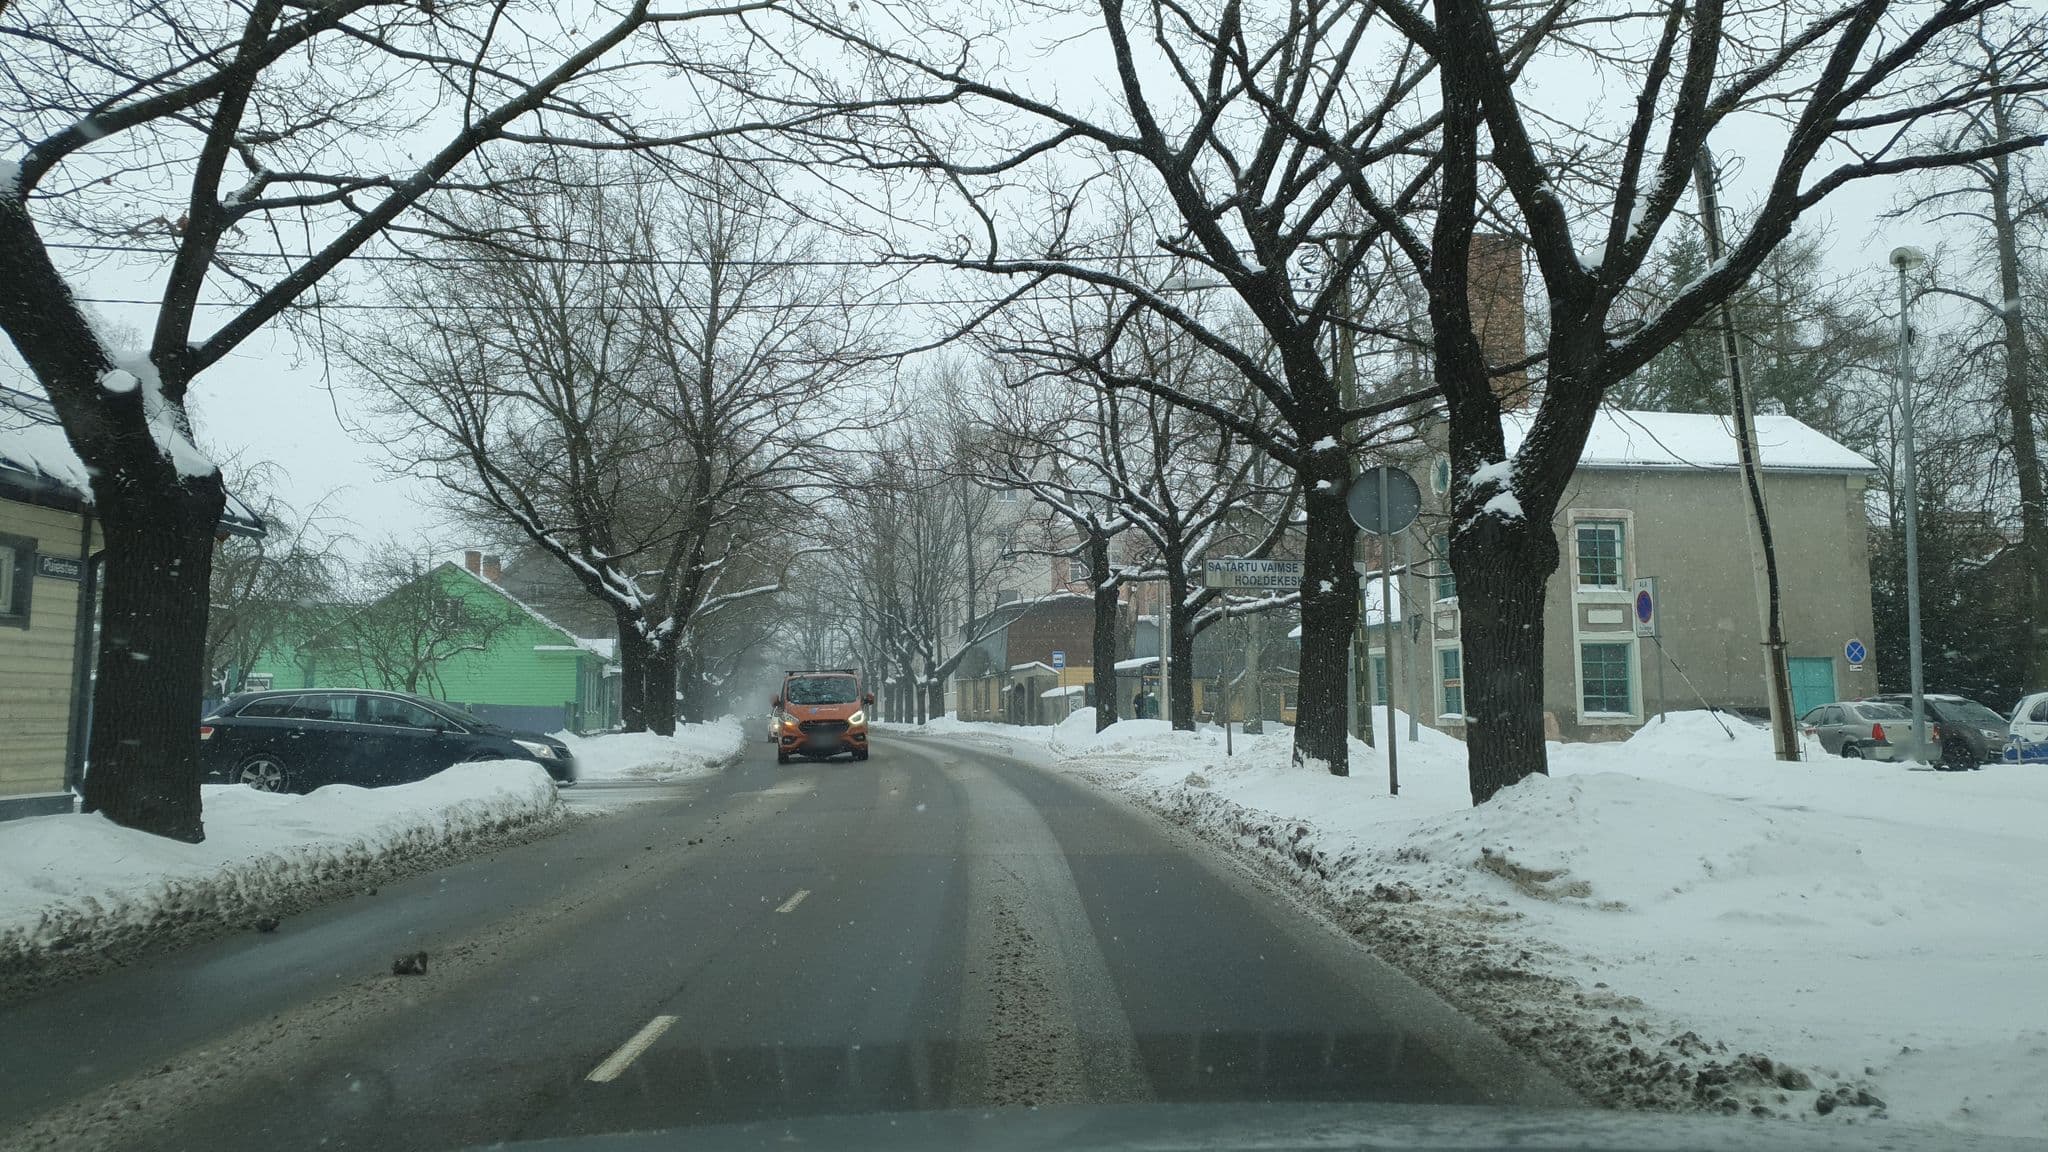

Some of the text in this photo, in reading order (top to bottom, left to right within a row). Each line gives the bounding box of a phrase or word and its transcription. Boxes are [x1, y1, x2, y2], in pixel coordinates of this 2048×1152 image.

[1208, 562, 1299, 573] SA TARTU VAIMSE
